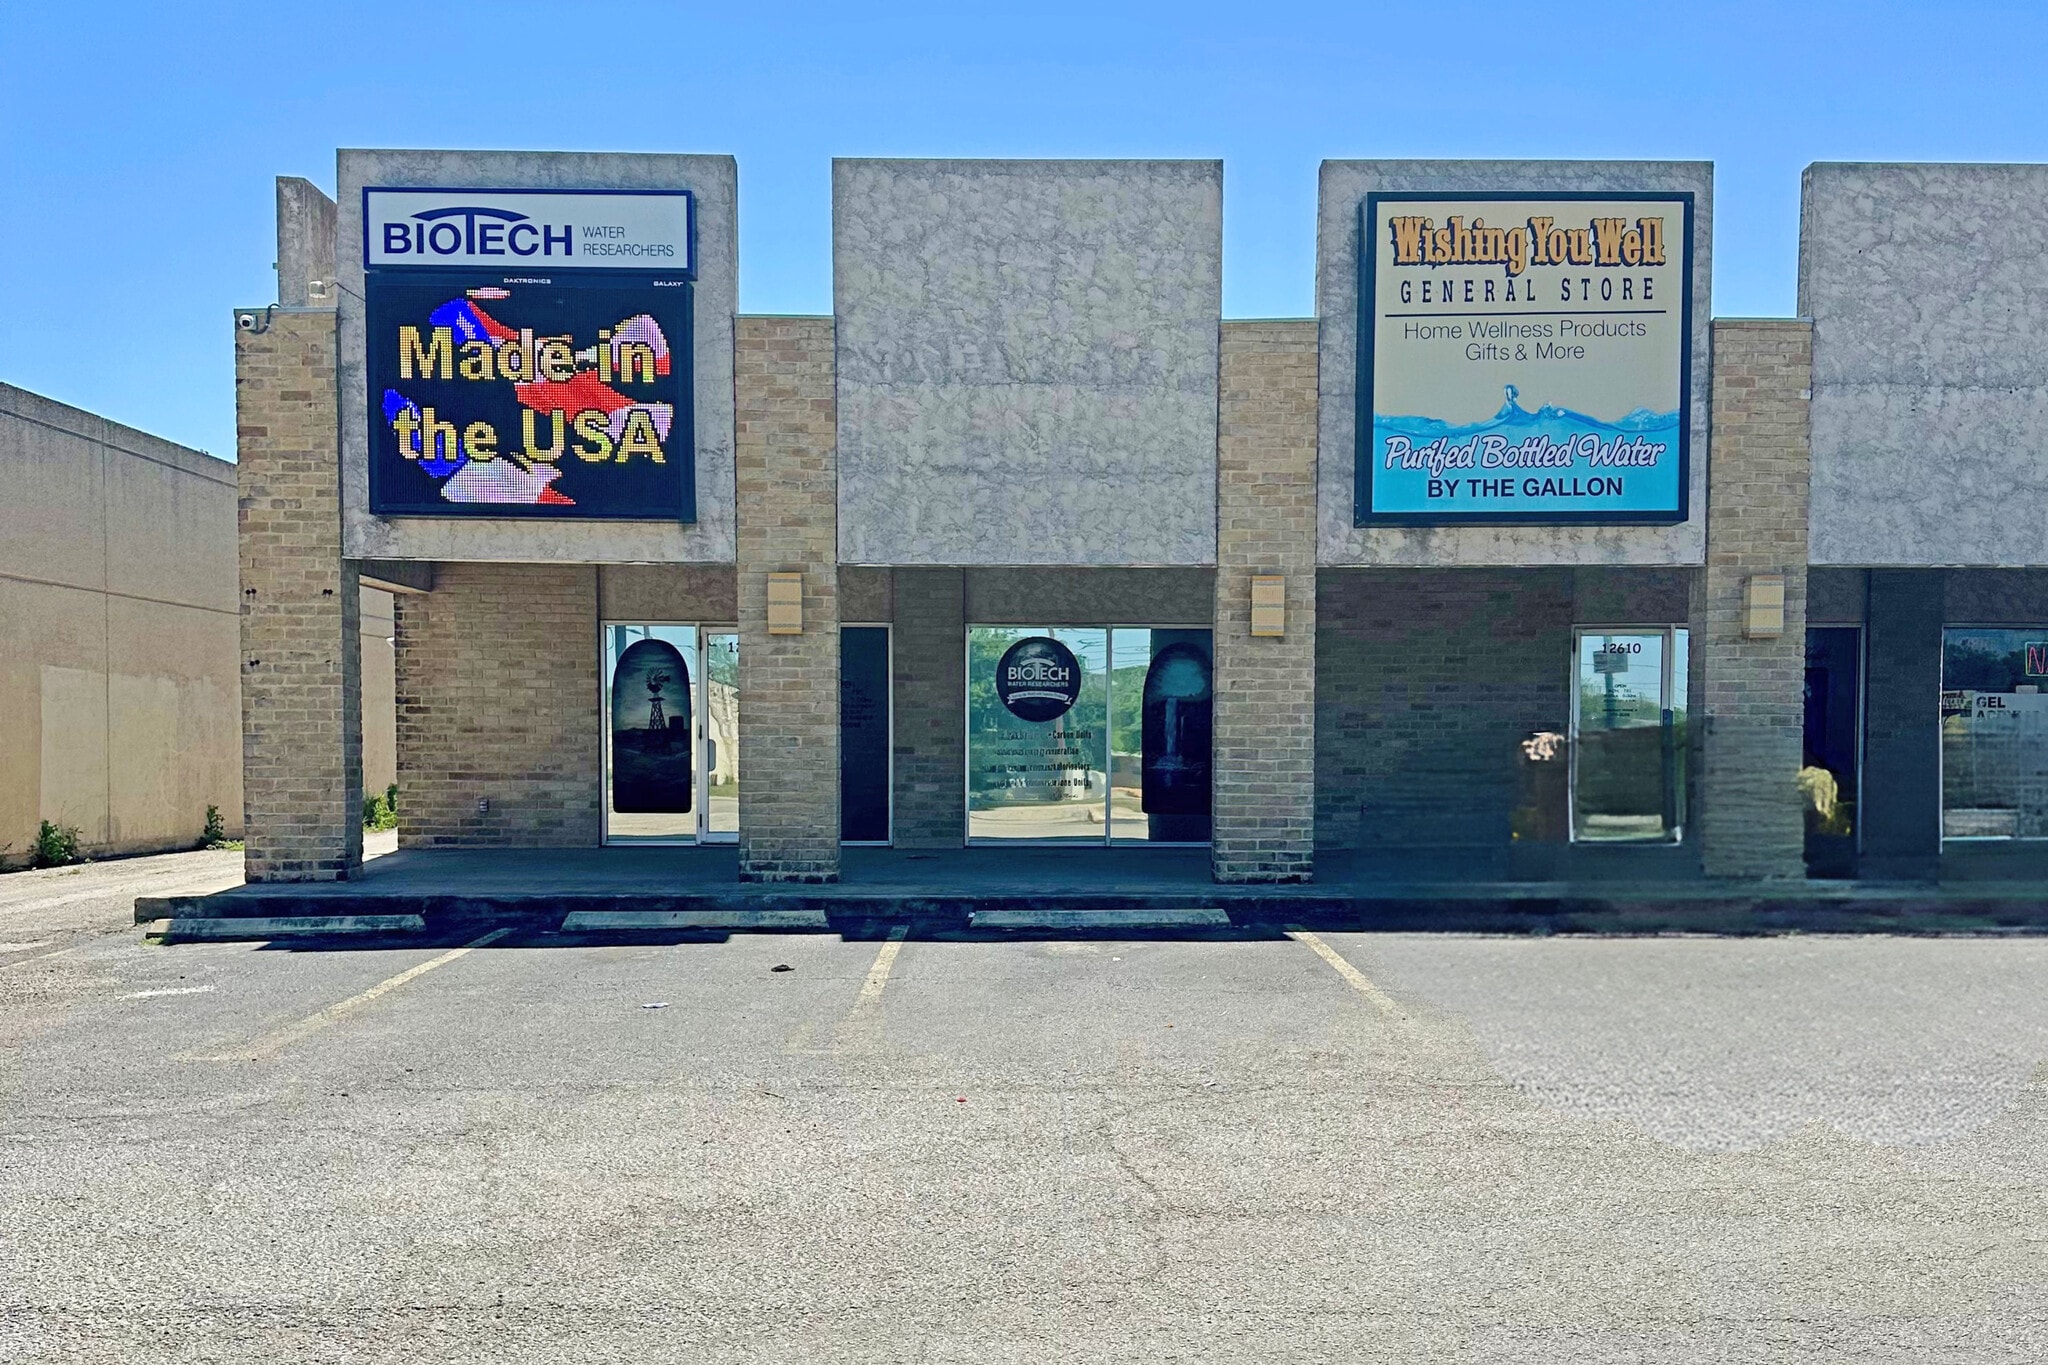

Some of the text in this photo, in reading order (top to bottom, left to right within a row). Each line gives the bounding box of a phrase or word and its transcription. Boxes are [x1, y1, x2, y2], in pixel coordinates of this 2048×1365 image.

[383, 206, 573, 257] BIOTECH
[582, 225, 625, 239] WATER
[583, 243, 674, 257] RESEARCHERS
[1389, 215, 1667, 277] Wishing You Well
[1400, 277, 1654, 303] GENERAL STORE
[1404, 319, 1647, 340] Home Wellness Products
[399, 325, 655, 384] Made in
[1465, 342, 1585, 361] Gifts & More
[393, 406, 666, 465] the USA
[1481, 434, 1577, 470] Bottled
[1576, 433, 1667, 468] Water
[1427, 477, 1623, 498] BY THE GALLON
[1602, 643, 1641, 654] 12610
[1008, 658, 1069, 680] BIOTECH
[1976, 696, 2006, 708] GEL
